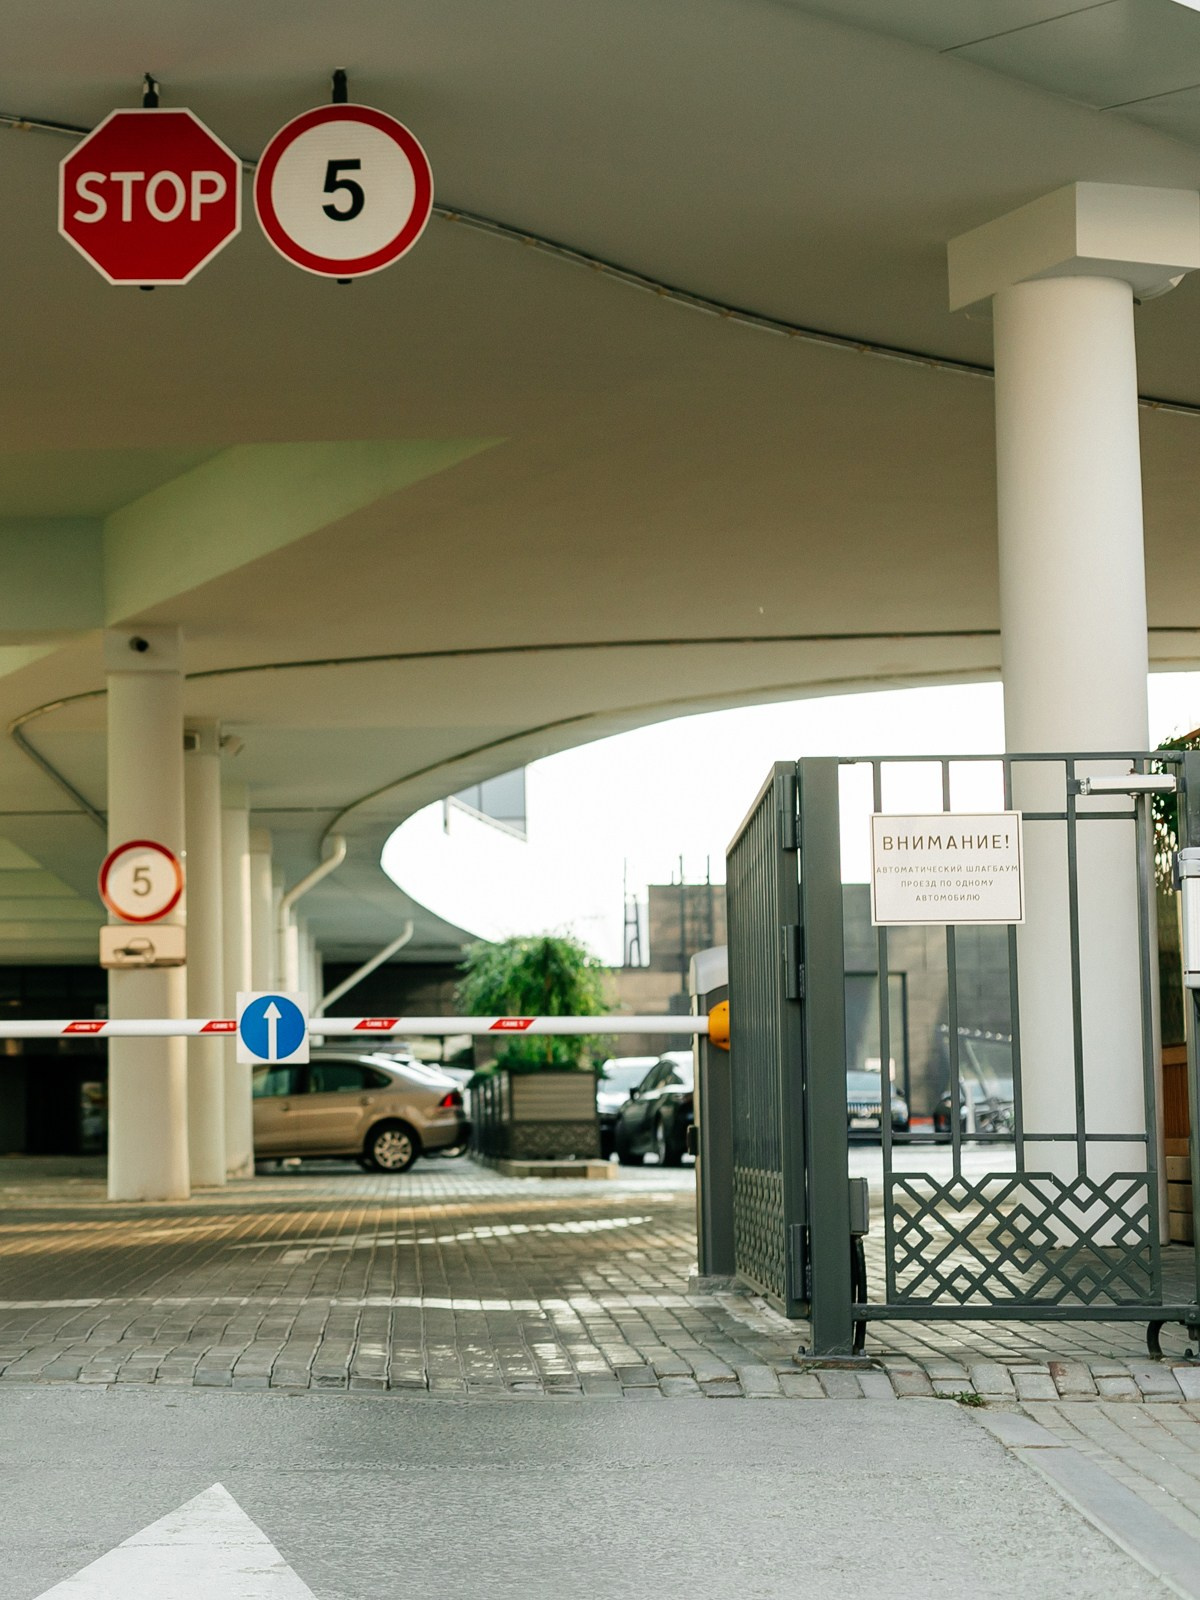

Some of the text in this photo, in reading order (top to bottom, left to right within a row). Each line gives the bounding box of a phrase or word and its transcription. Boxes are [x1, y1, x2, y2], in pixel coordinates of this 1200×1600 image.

[73, 170, 228, 224] STOP
[321, 158, 365, 222] 5
[883, 834, 1009, 850] ВНИМАНИЕ!
[876, 865, 962, 874] АВТОМАТИЧЕСКИЙ
[133, 867, 152, 896] 5
[901, 880, 937, 888] ПРОЕЗД
[956, 879, 994, 887] ОДНОМУ
[915, 893, 981, 902] АВТОМОБИЛЮ
